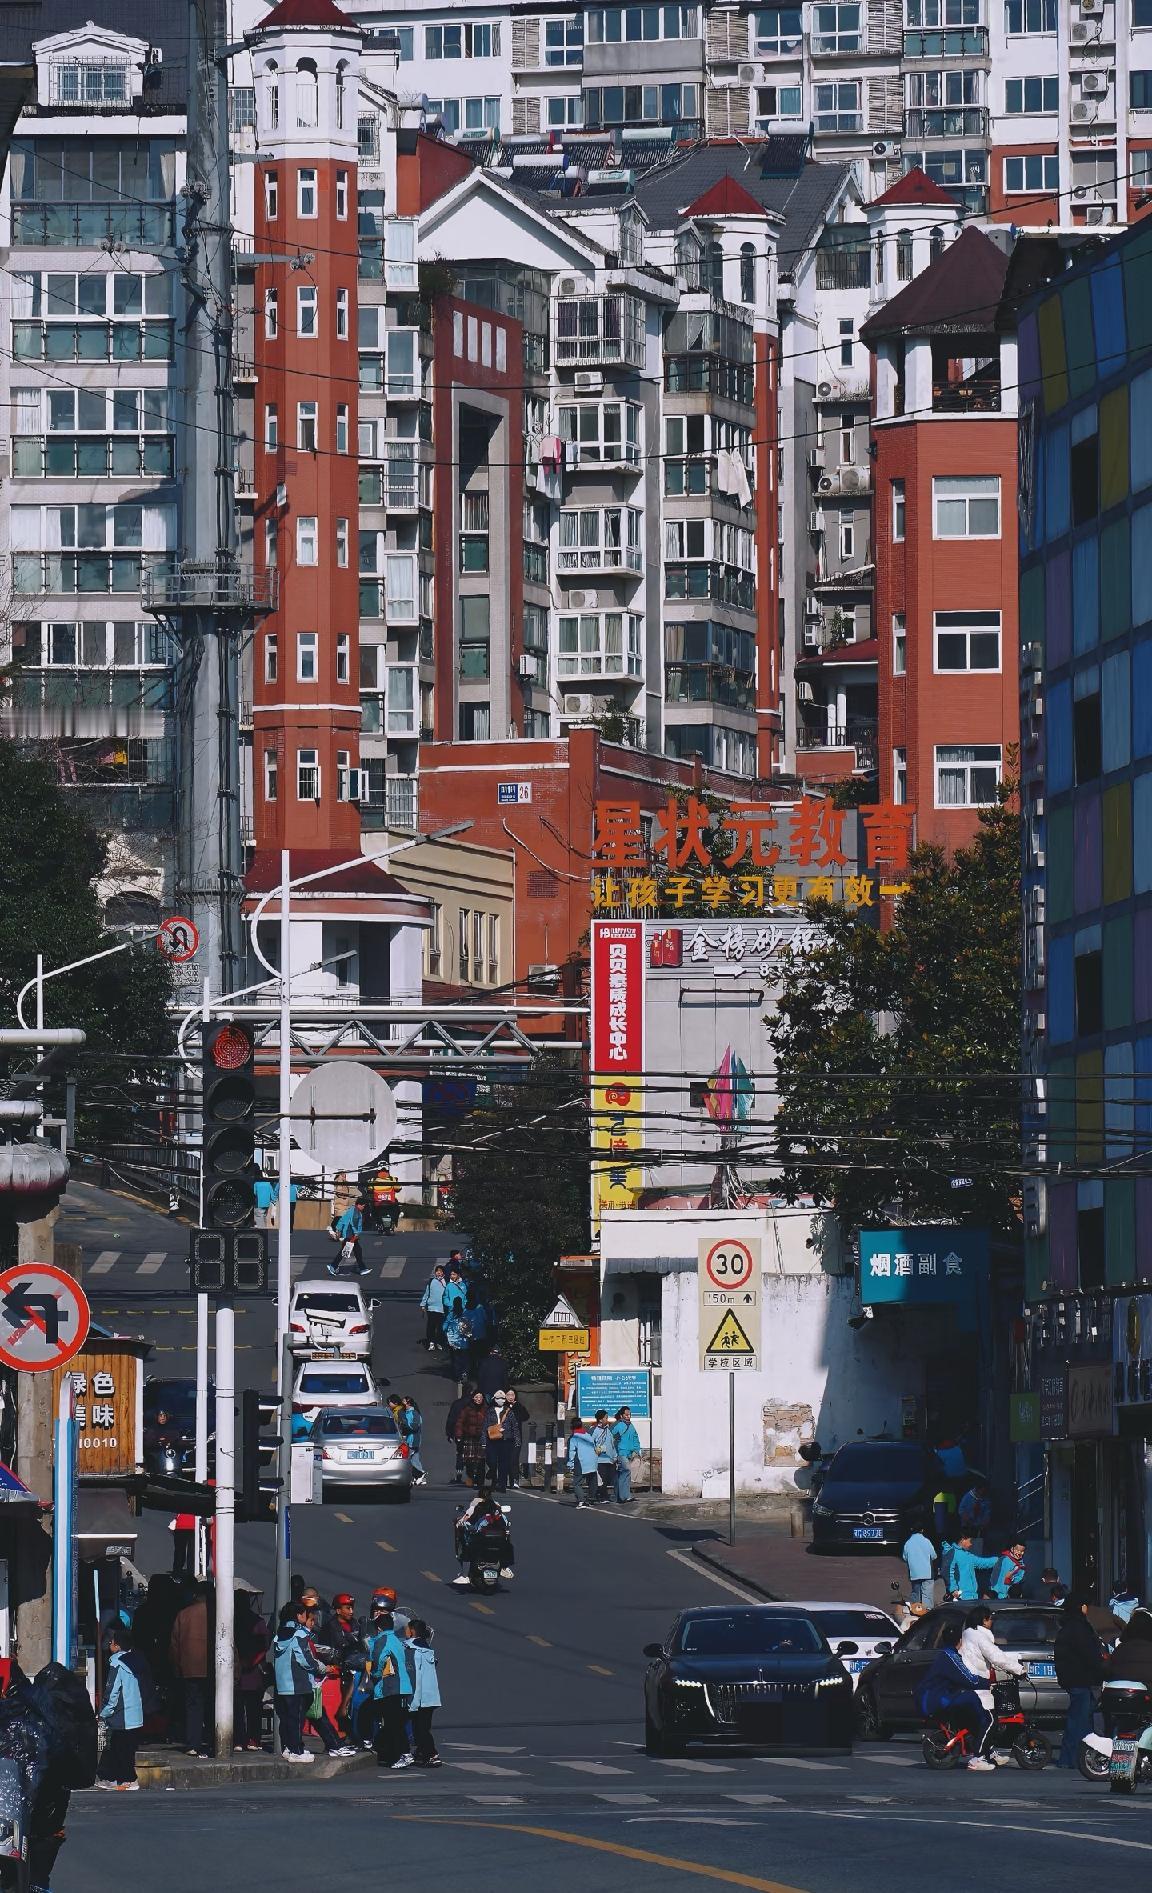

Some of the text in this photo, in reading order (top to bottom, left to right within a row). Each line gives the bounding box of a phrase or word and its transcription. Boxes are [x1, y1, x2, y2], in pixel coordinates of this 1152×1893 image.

[591, 796, 917, 870] 星状元教育
[716, 1253, 744, 1275] 30
[869, 1251, 963, 1277] 烟酒副食
[708, 1357, 753, 1369] 学校区域
